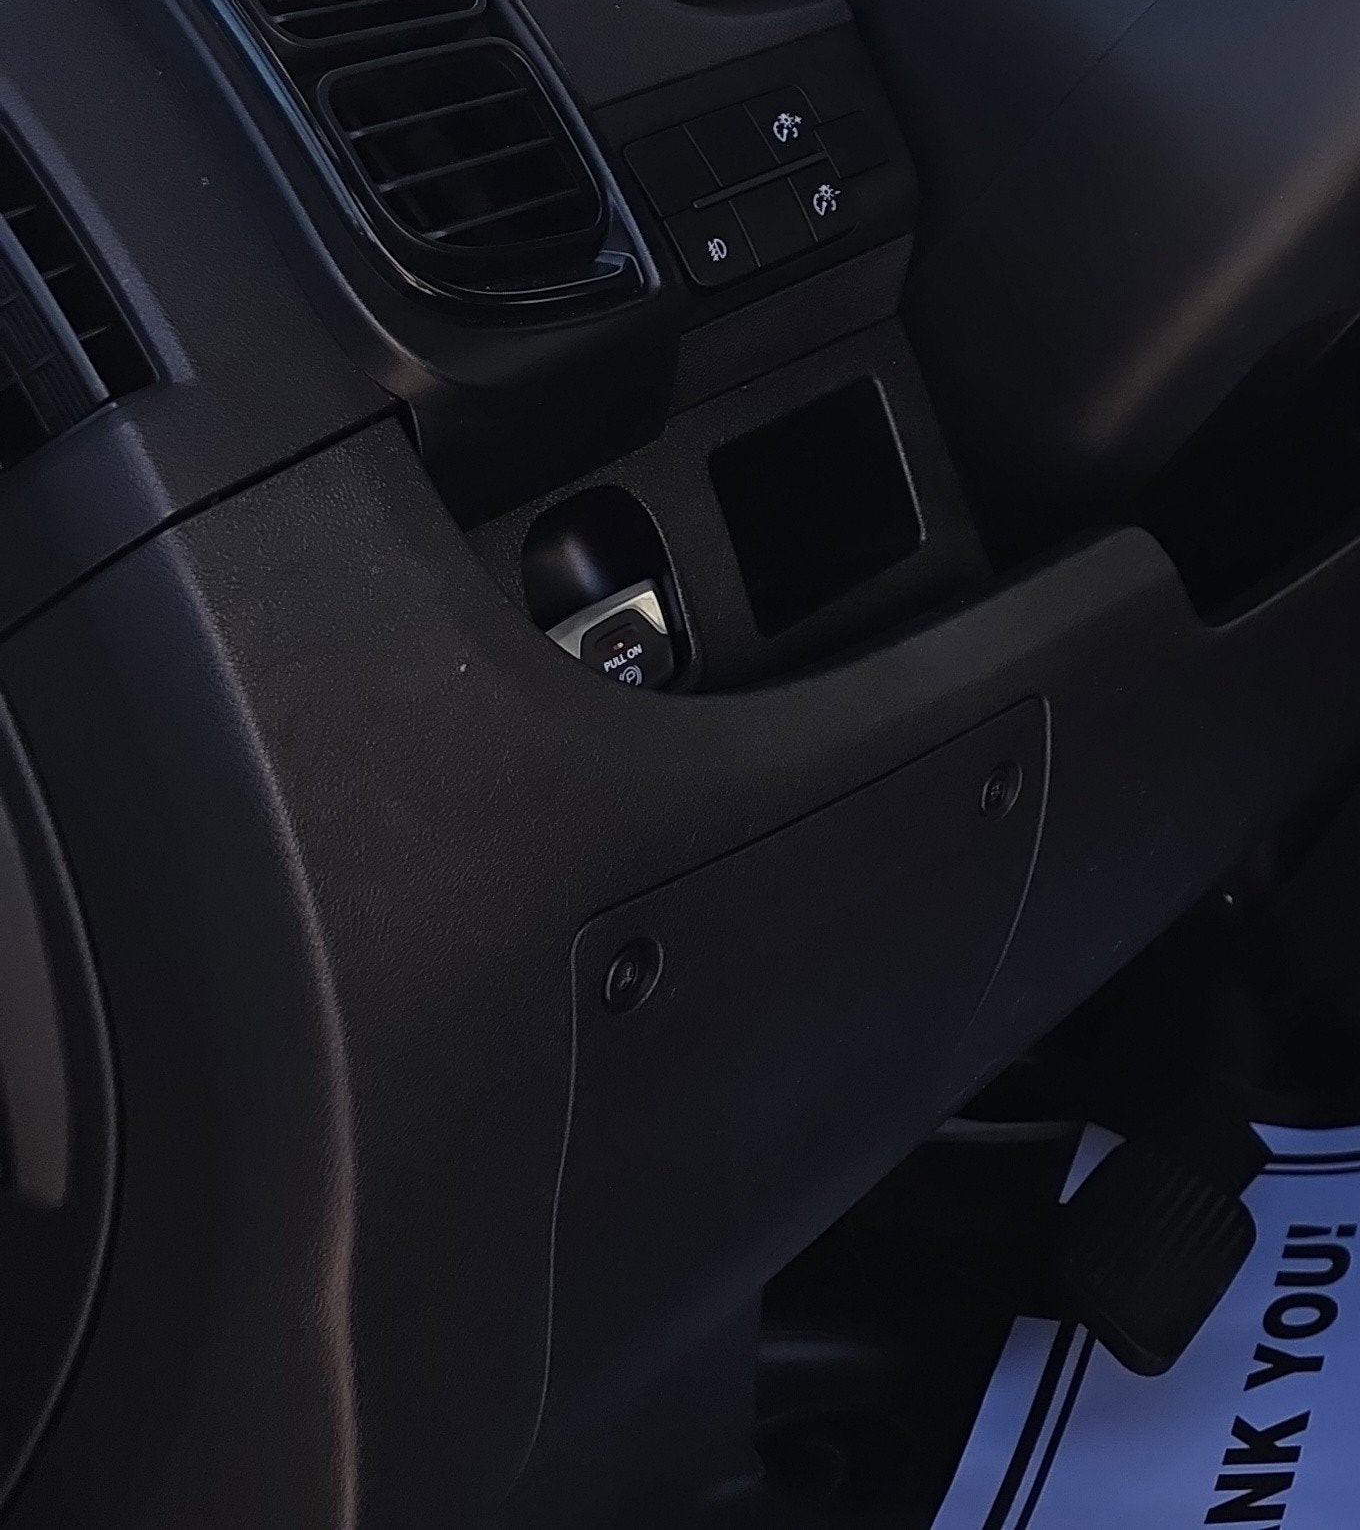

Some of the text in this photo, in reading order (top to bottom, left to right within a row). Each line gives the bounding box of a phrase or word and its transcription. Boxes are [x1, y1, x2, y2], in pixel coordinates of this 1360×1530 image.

[603, 644, 642, 672] PULL ON
[1243, 1223, 1358, 1392] YOU!
